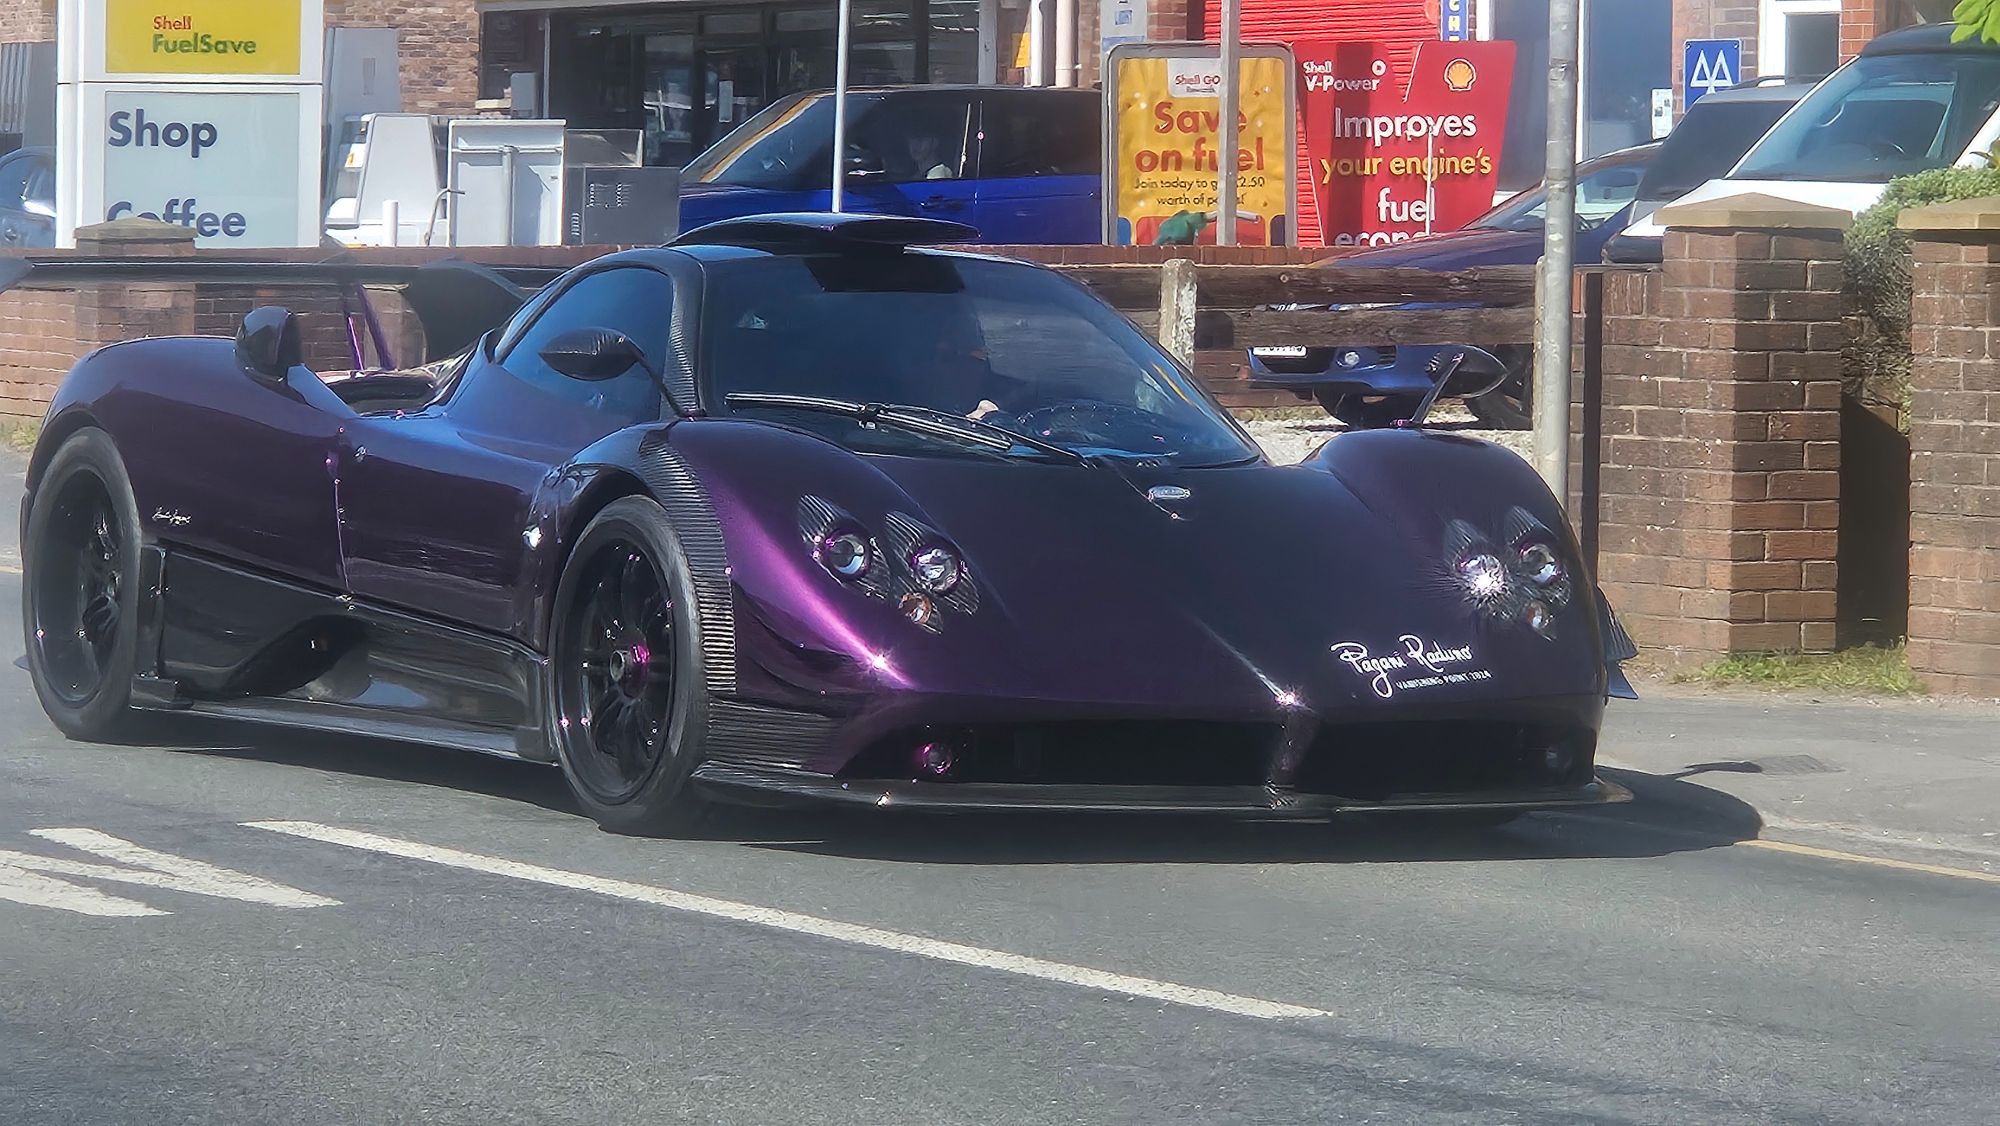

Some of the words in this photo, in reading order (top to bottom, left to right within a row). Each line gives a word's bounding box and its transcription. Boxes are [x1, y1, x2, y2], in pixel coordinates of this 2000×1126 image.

[153, 16, 192, 30] Shell
[152, 33, 257, 54] FuelSave
[1302, 61, 1332, 74] Shell
[1303, 75, 1380, 92] V-Power
[108, 108, 218, 158] Shop
[1334, 107, 1477, 147] Improves
[1135, 150, 1183, 172] on
[1320, 157, 1384, 184] your
[1389, 147, 1492, 182] engine's
[1134, 178, 1158, 189] Join
[1160, 177, 1194, 191] today
[1196, 180, 1208, 188] to
[1236, 176, 1266, 188] 2.50
[1156, 193, 1190, 206] worth
[1193, 193, 1205, 205] of
[1377, 187, 1436, 223] fuel
[1330, 641, 1408, 698] Pagani
[1398, 634, 1474, 673] Raduno
